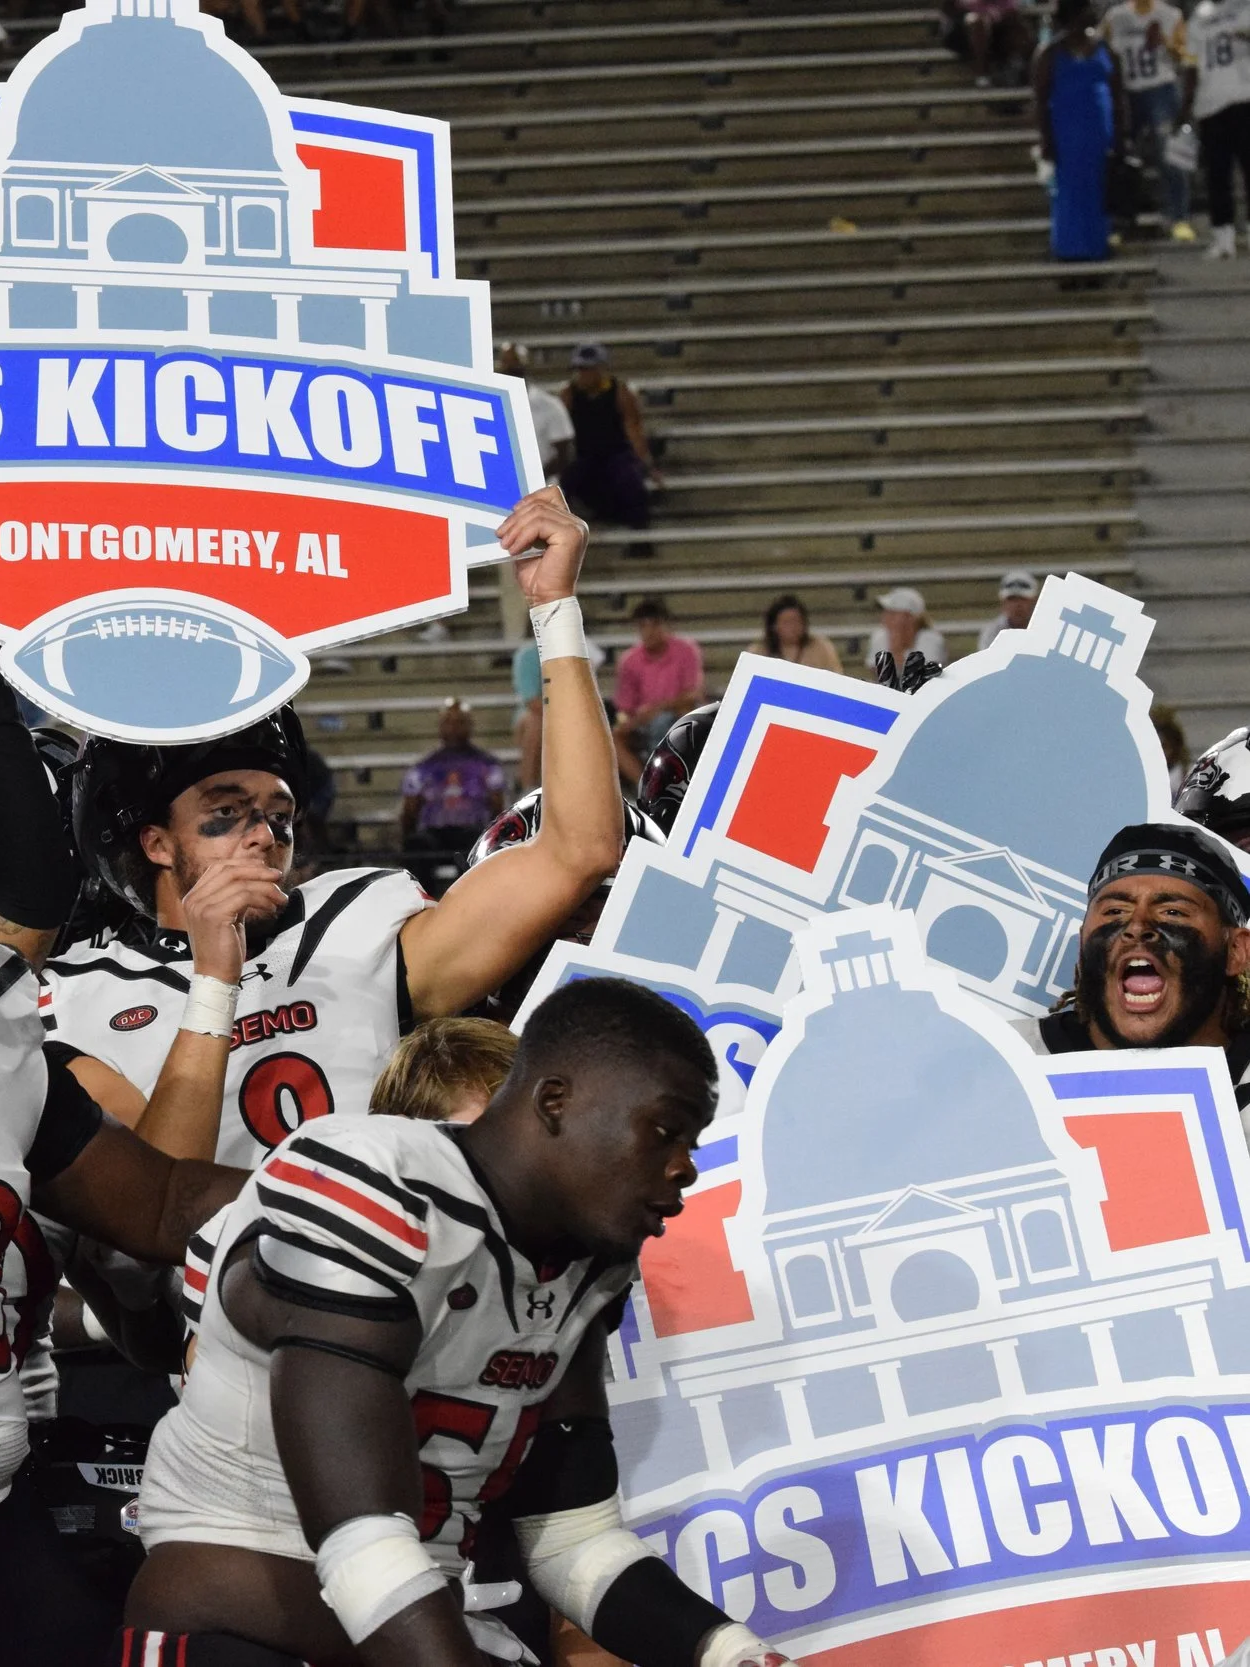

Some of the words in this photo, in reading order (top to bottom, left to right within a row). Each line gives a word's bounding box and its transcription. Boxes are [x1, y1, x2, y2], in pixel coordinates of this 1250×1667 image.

[36, 355, 498, 490] KICKOFF
[296, 533, 349, 580] AL
[120, 1009, 146, 1026] OVC
[479, 1350, 559, 1390] SEMO
[638, 1485, 837, 1623] CS
[854, 1415, 1250, 1587] KICKO
